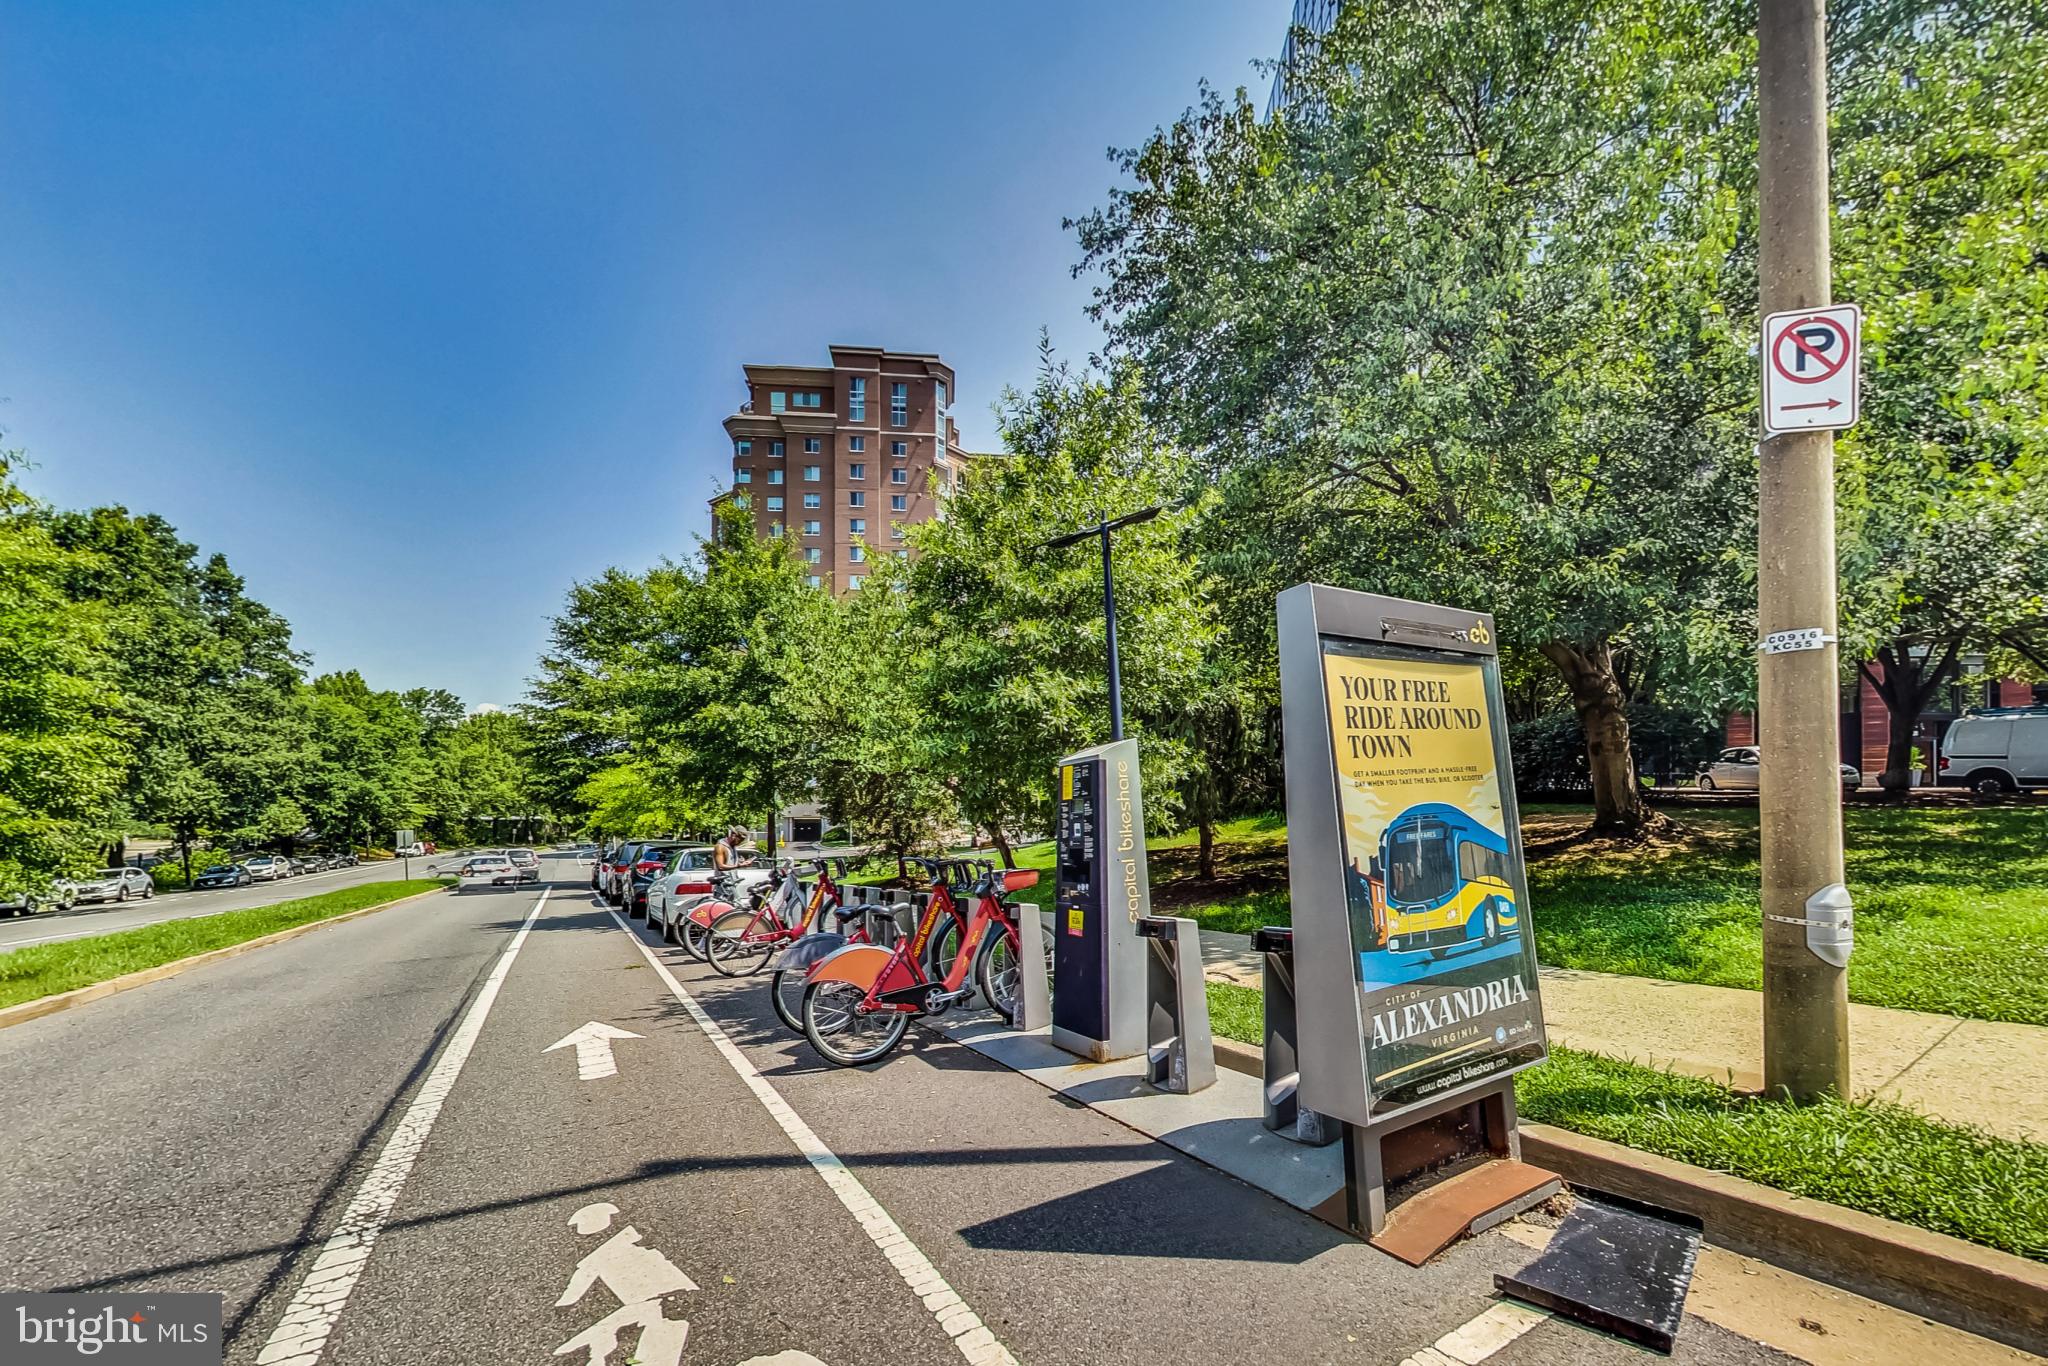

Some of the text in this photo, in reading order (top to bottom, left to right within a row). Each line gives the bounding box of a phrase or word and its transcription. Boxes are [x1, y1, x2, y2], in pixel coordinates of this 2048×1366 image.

[1773, 640, 1812, 651] KC55
[1340, 675, 1450, 703] YOUR FREE
[1344, 705, 1482, 730] RIDE AROUND
[1348, 735, 1412, 759] TOWN
[1367, 779, 1385, 787] WHEN
[1370, 769, 1395, 777] SMALLER
[1117, 759, 1142, 924] capital bikeshare
[1385, 989, 1421, 1006] CITY OF
[1371, 974, 1529, 1050] ALEXANDRIA
[1430, 1025, 1480, 1048] VIRGINIA
